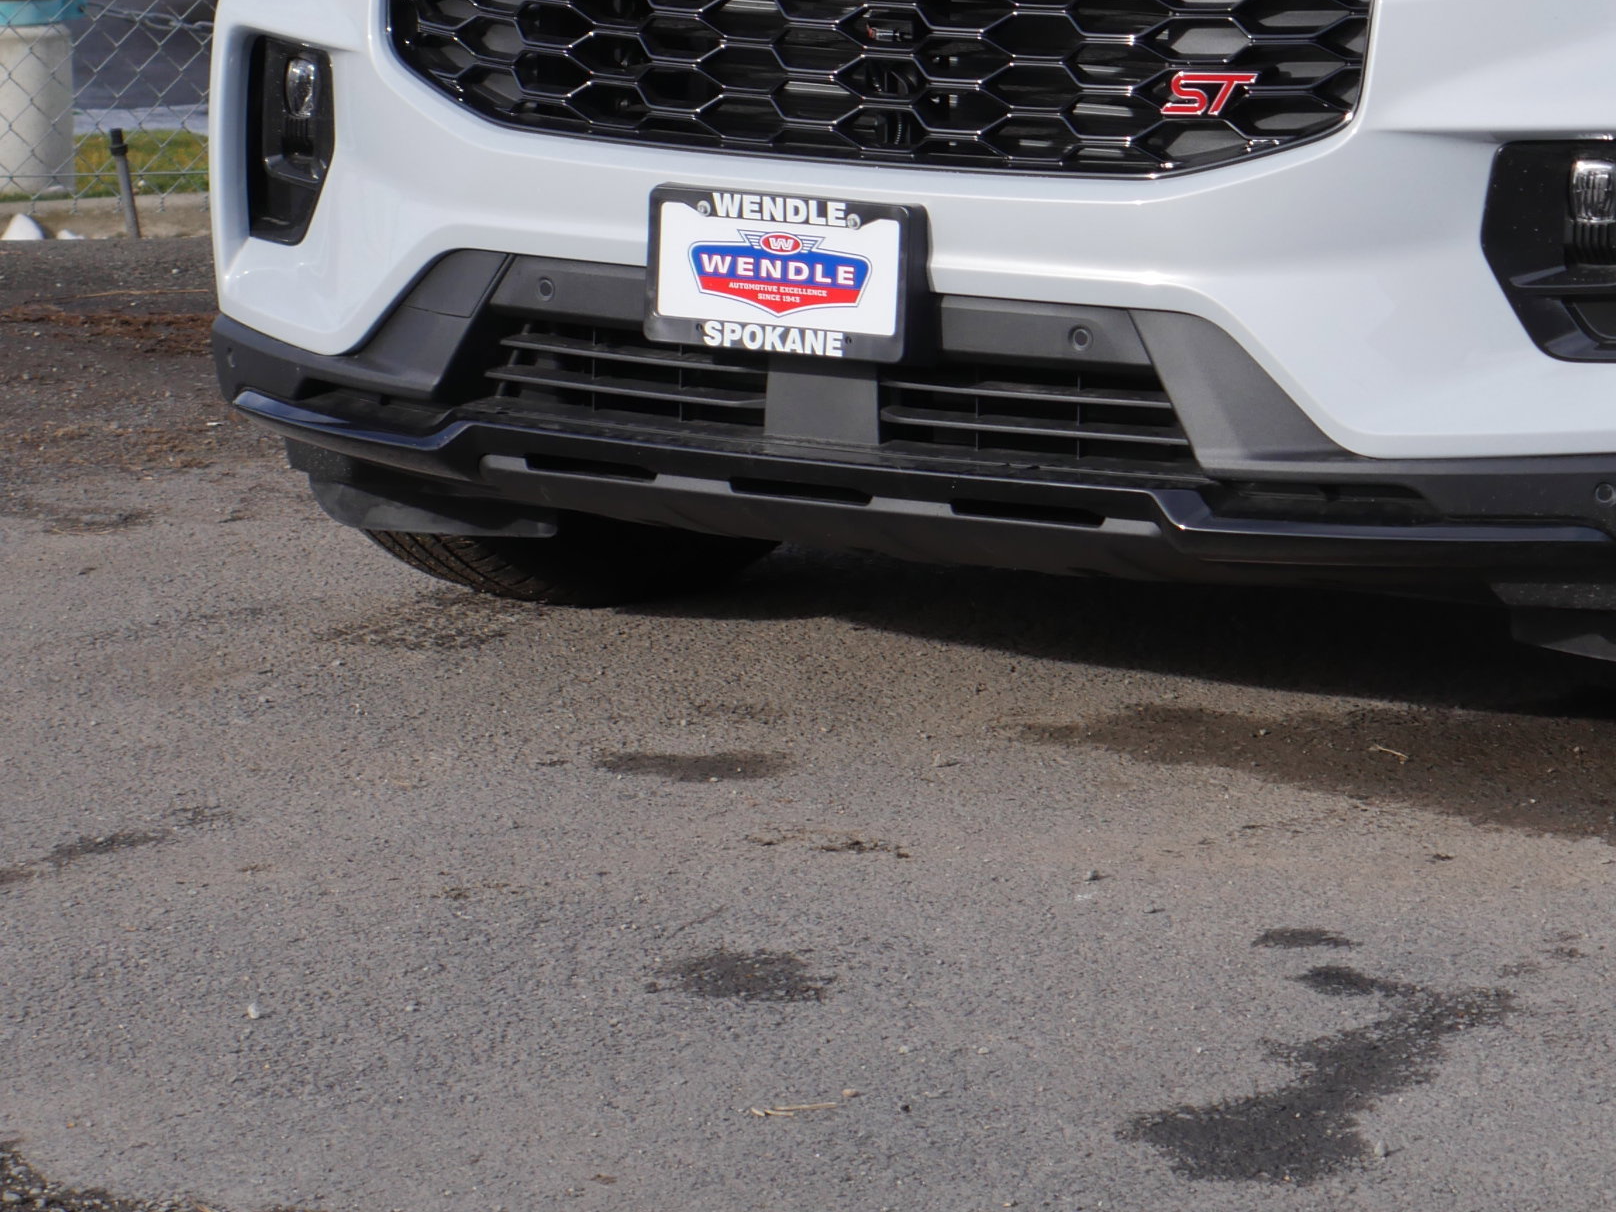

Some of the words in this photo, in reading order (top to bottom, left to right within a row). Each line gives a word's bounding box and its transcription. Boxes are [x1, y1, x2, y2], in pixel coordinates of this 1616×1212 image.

[1161, 72, 1258, 116] ST
[712, 191, 848, 228] WENDLE
[700, 253, 855, 285] WENDLE
[729, 281, 778, 293] AUTOMOTIVE
[779, 286, 828, 297] EXCELLENCE
[757, 293, 781, 302] SINCE
[782, 294, 801, 303] 1943
[703, 321, 843, 357] SPOKANE
